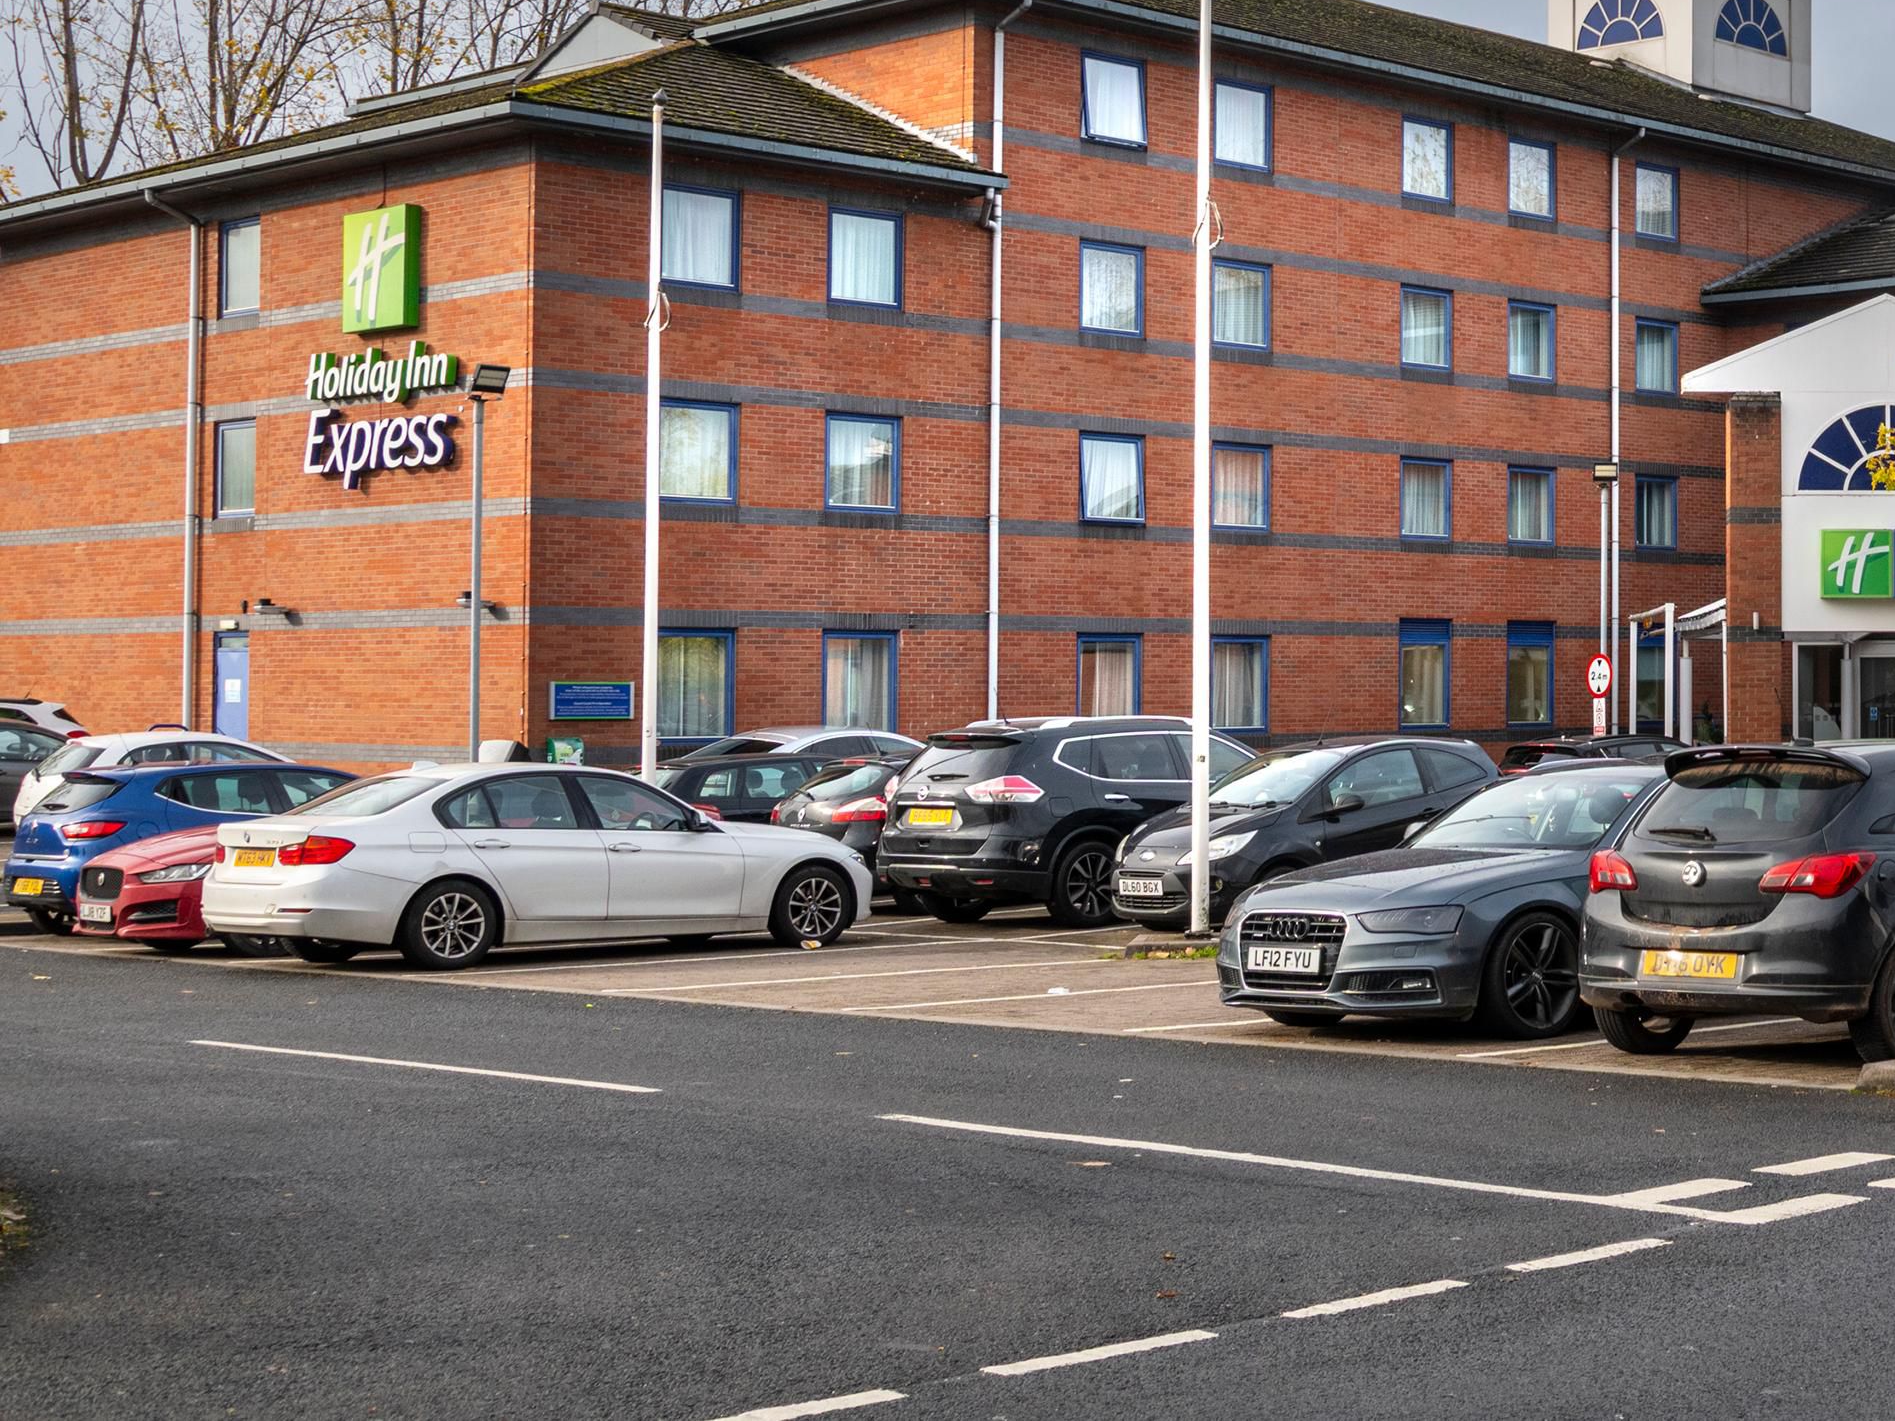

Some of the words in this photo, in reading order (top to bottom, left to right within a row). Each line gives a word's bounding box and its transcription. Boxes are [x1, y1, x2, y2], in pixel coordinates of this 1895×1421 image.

[305, 346, 404, 403] Holiday
[405, 340, 449, 389] Inn
[304, 409, 450, 490] Express
[1122, 881, 1141, 892] DL60
[1143, 882, 1159, 893] BGX
[1254, 950, 1281, 967] LF12
[1284, 951, 1312, 968] FYU
[1693, 955, 1727, 974] OYK
